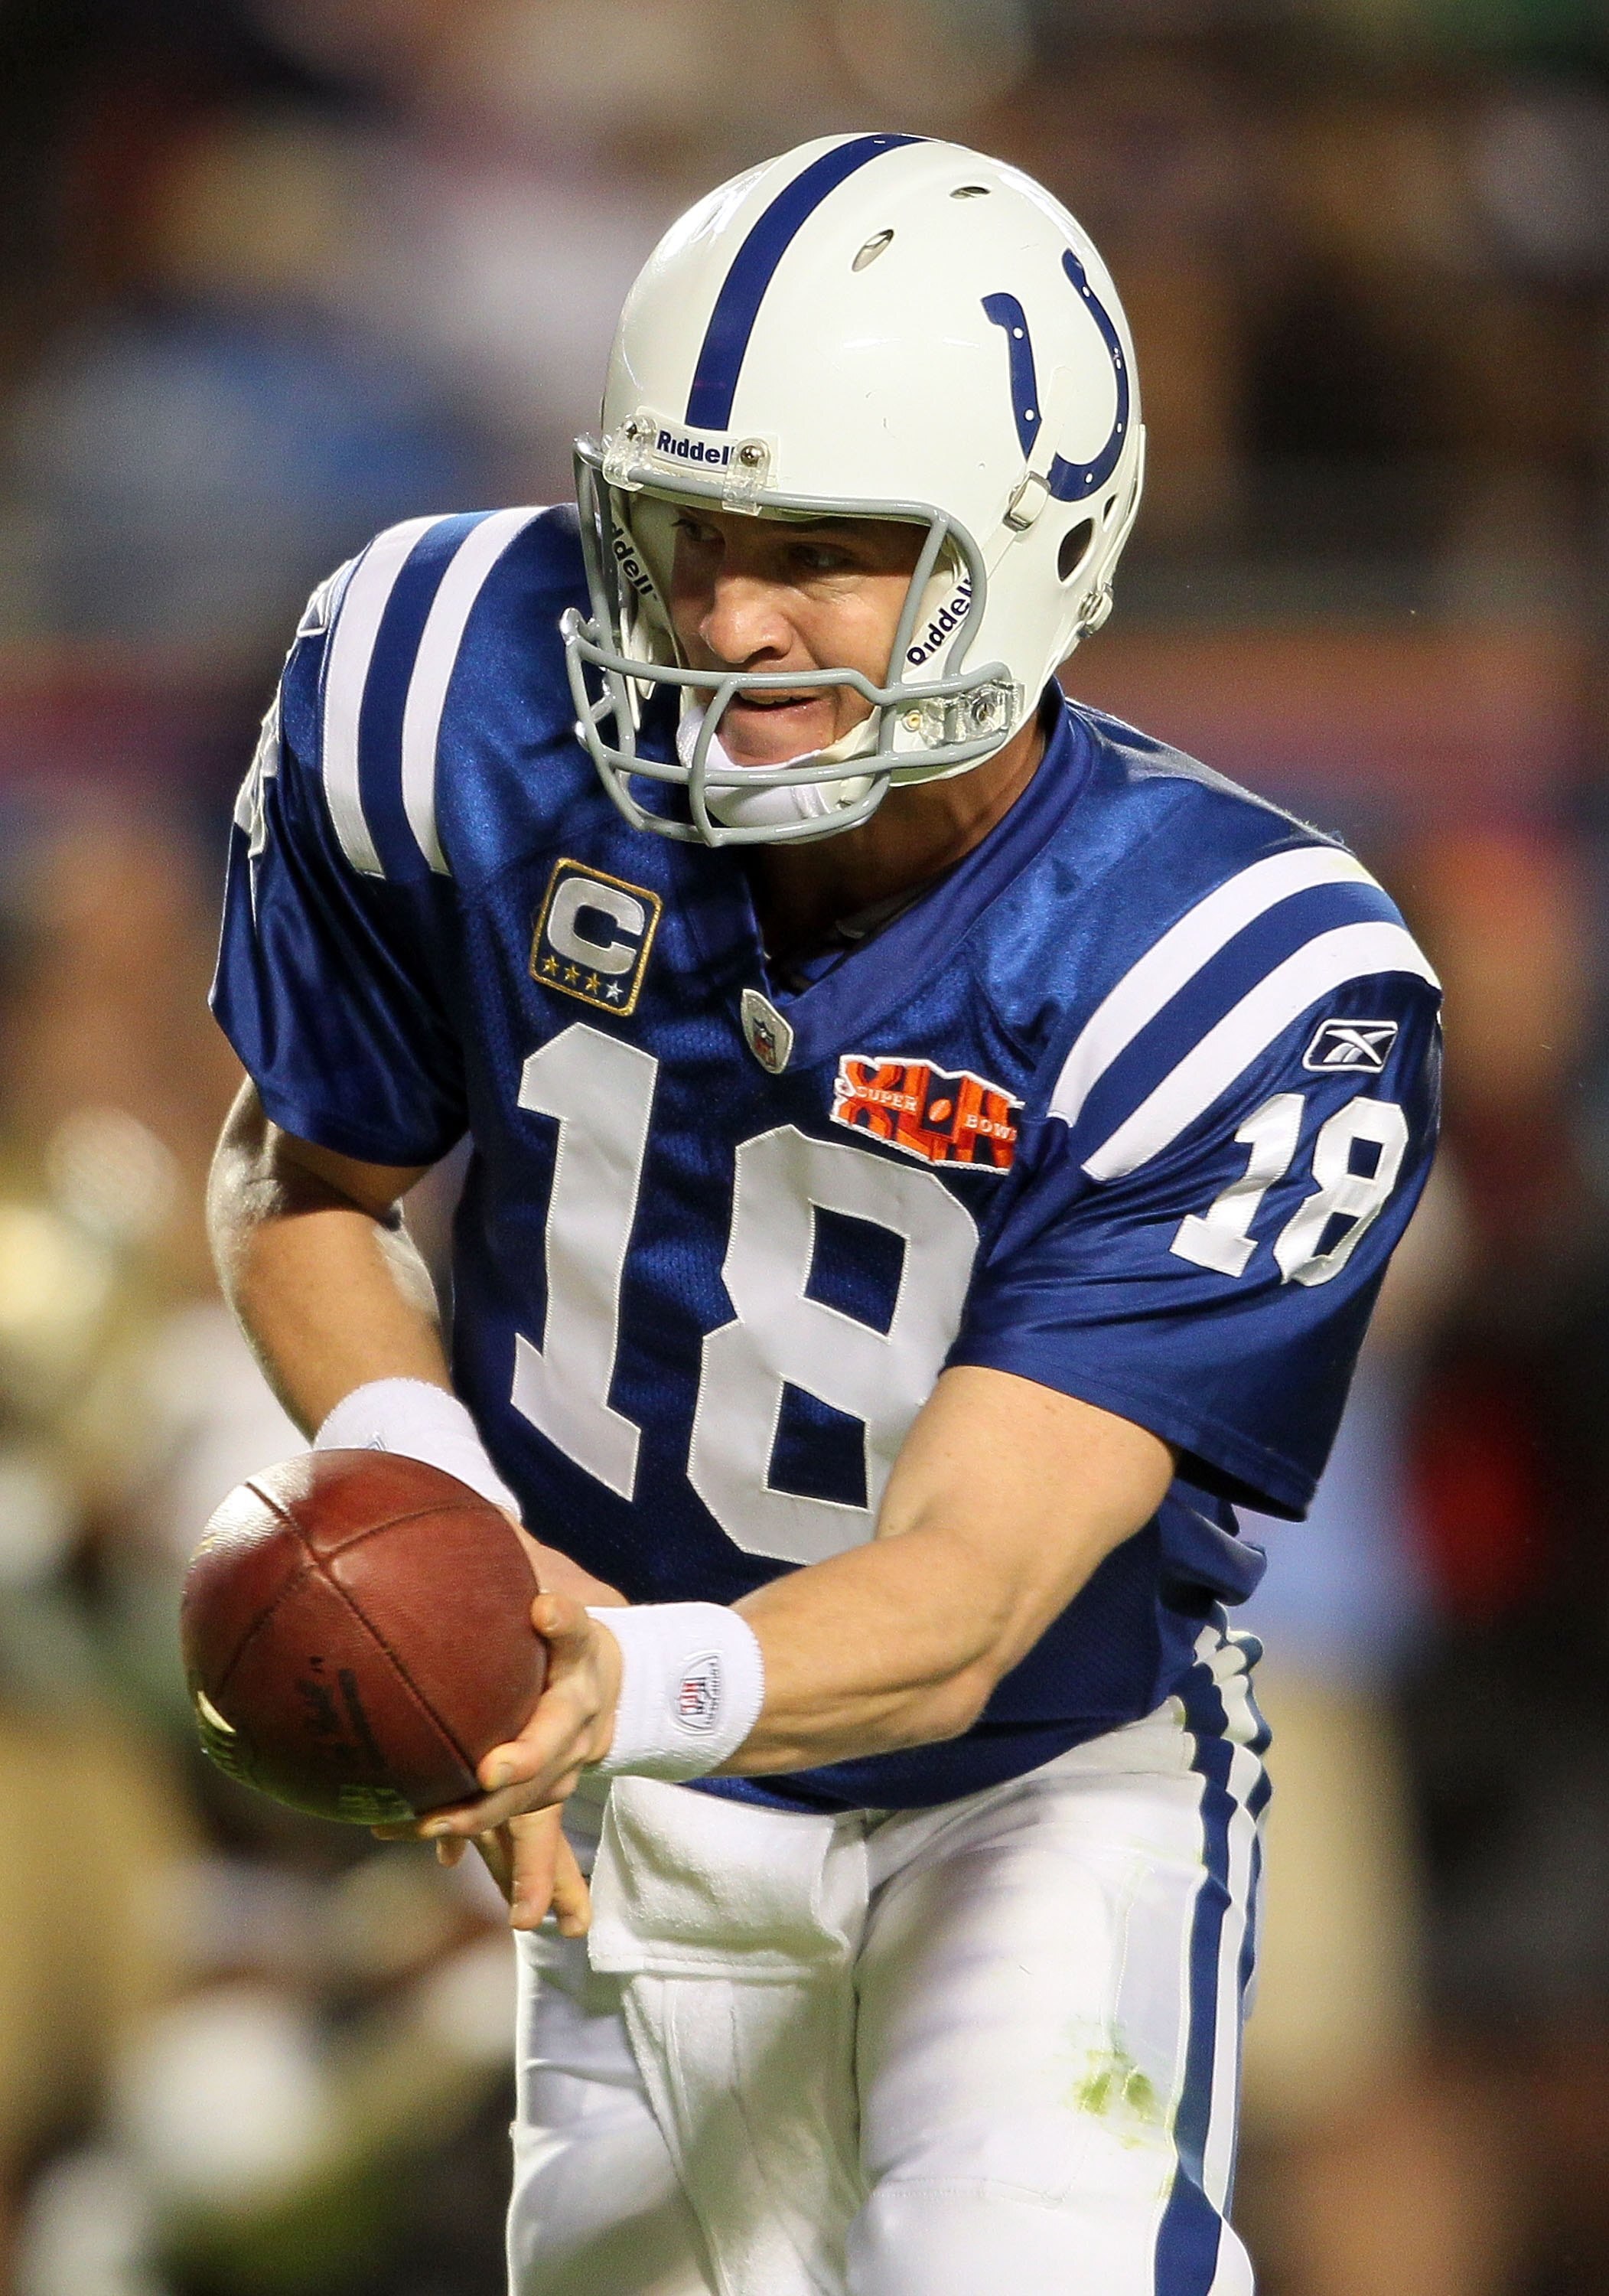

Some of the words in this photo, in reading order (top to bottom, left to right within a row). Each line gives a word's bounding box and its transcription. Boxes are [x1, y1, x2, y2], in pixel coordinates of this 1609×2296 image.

[906, 578, 972, 665] Riddel
[547, 877, 645, 974] C
[964, 1113, 1018, 1141] BOW
[1169, 1093, 1409, 1287] 18
[510, 1022, 980, 1566] 18
